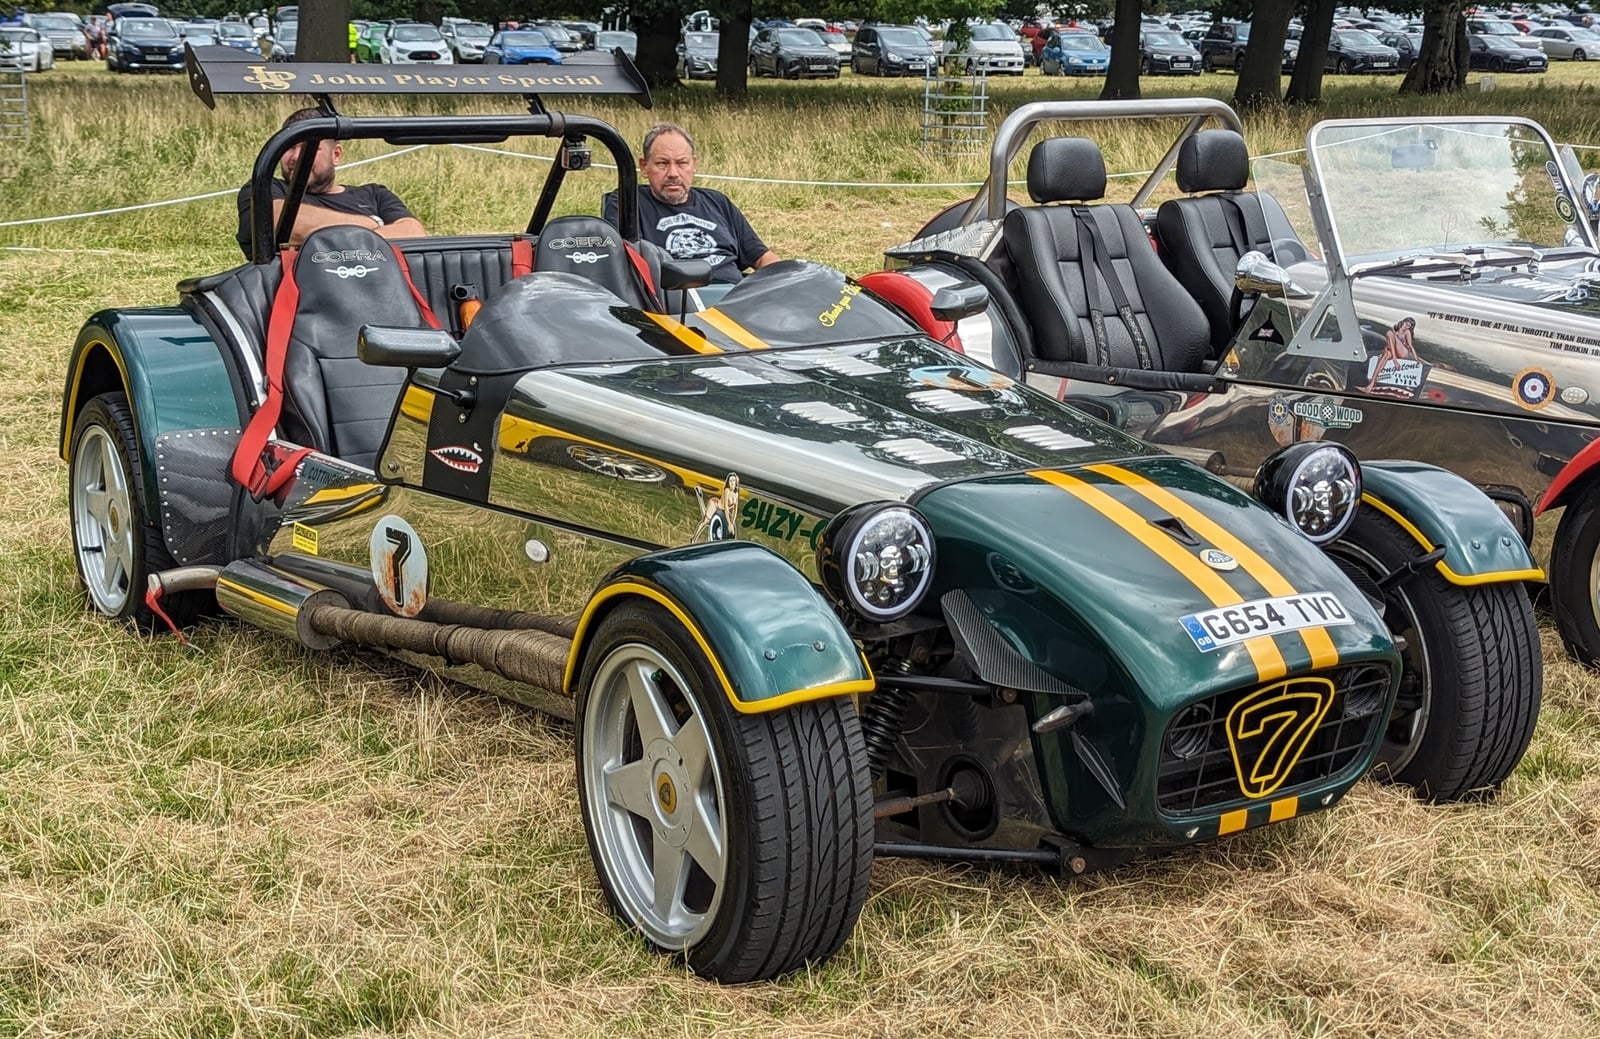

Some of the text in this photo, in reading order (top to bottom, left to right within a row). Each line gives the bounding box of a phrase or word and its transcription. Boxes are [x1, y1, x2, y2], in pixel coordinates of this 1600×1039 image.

[309, 74, 603, 88] John Player Special
[548, 235, 617, 250] COBRA
[311, 248, 388, 264] COBRA
[1445, 313, 1470, 324] BETTER
[1470, 318, 1480, 326] TO
[1480, 319, 1493, 329] DIE
[1493, 322, 1503, 330] AT
[1503, 323, 1520, 333] FULL
[1521, 326, 1555, 339] THROTTLE
[1556, 332, 1576, 342] THAN
[1549, 341, 1600, 357] TIM BIRKIN 18
[1296, 403, 1319, 417] GOOD
[1336, 406, 1361, 422] WOOD
[385, 526, 412, 608] 7
[1203, 597, 1346, 640] G654 TVO
[1198, 636, 1212, 646] GB
[1238, 692, 1322, 784] 7
